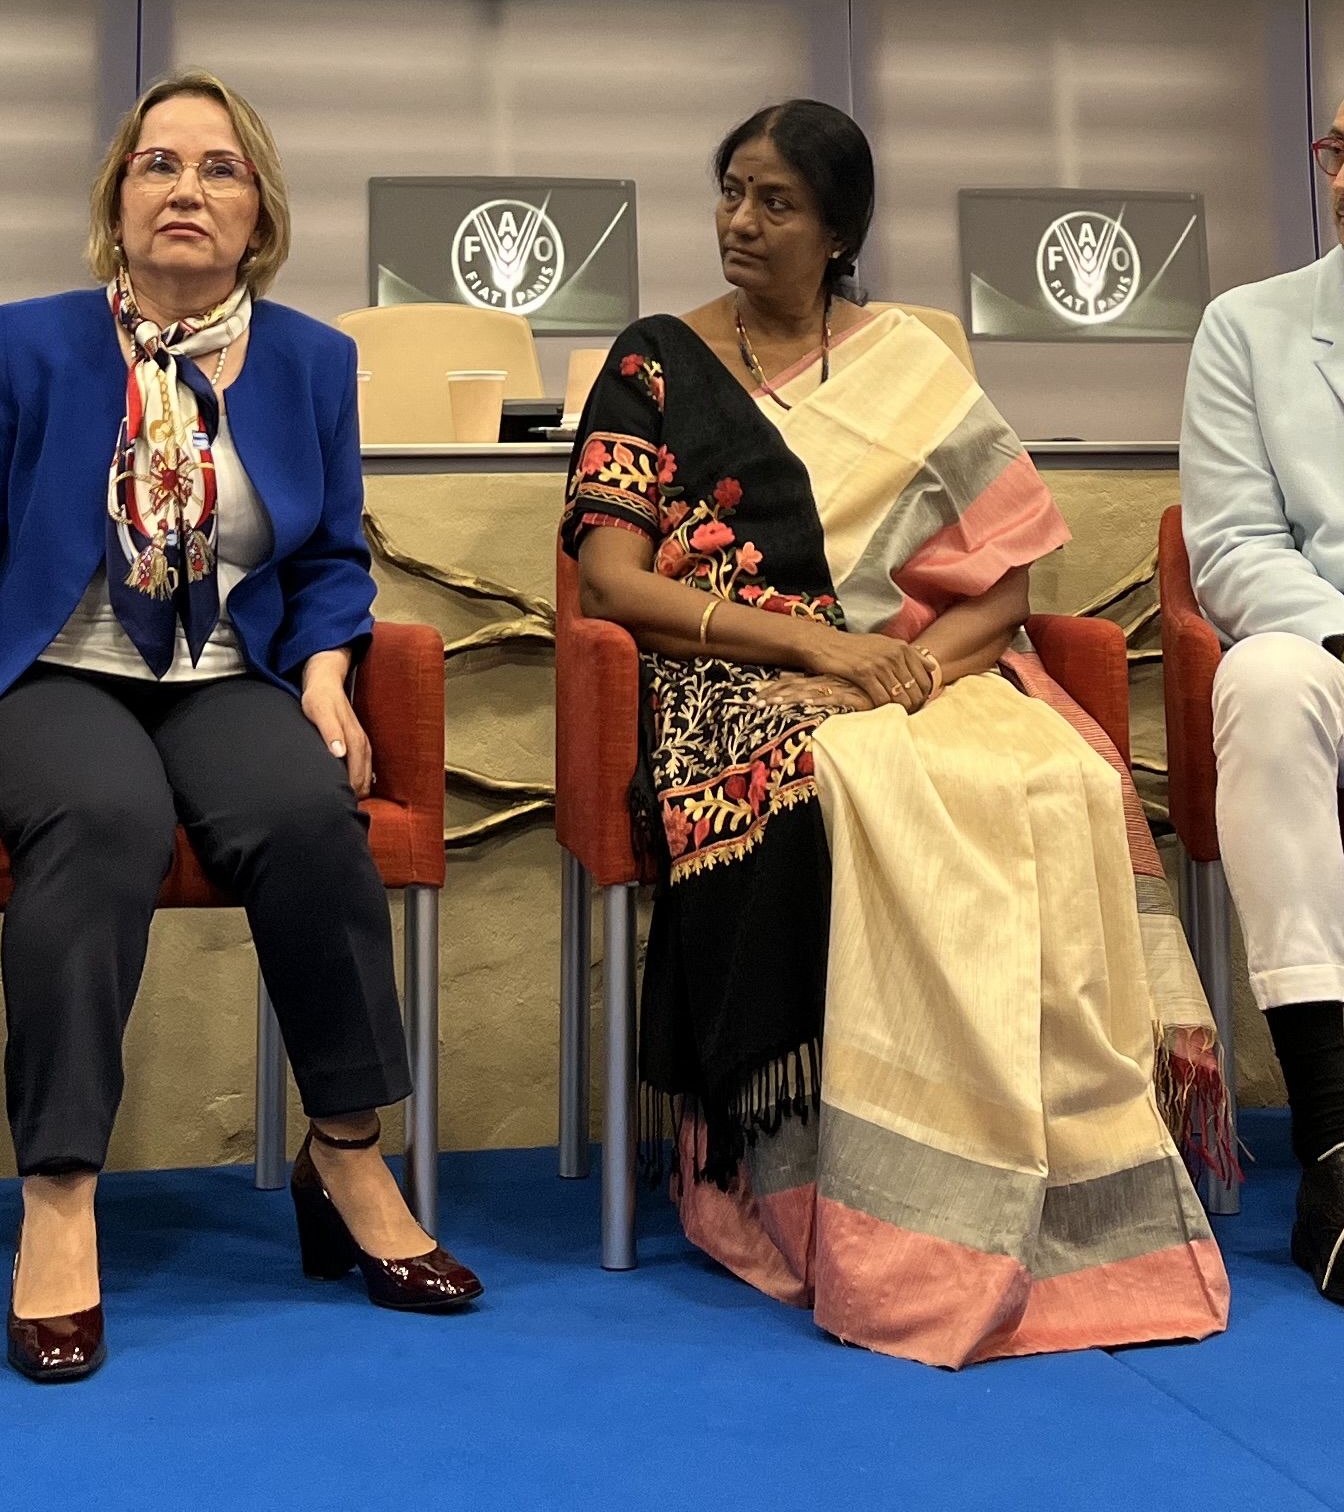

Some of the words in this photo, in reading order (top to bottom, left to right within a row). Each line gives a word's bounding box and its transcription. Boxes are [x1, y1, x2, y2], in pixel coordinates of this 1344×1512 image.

[463, 211, 554, 262] FAO
[1047, 223, 1130, 271] FAO
[465, 270, 502, 305] FIAT
[515, 266, 554, 304] PANIS
[1050, 279, 1085, 312] FIAT
[1098, 275, 1131, 312] PANIS
